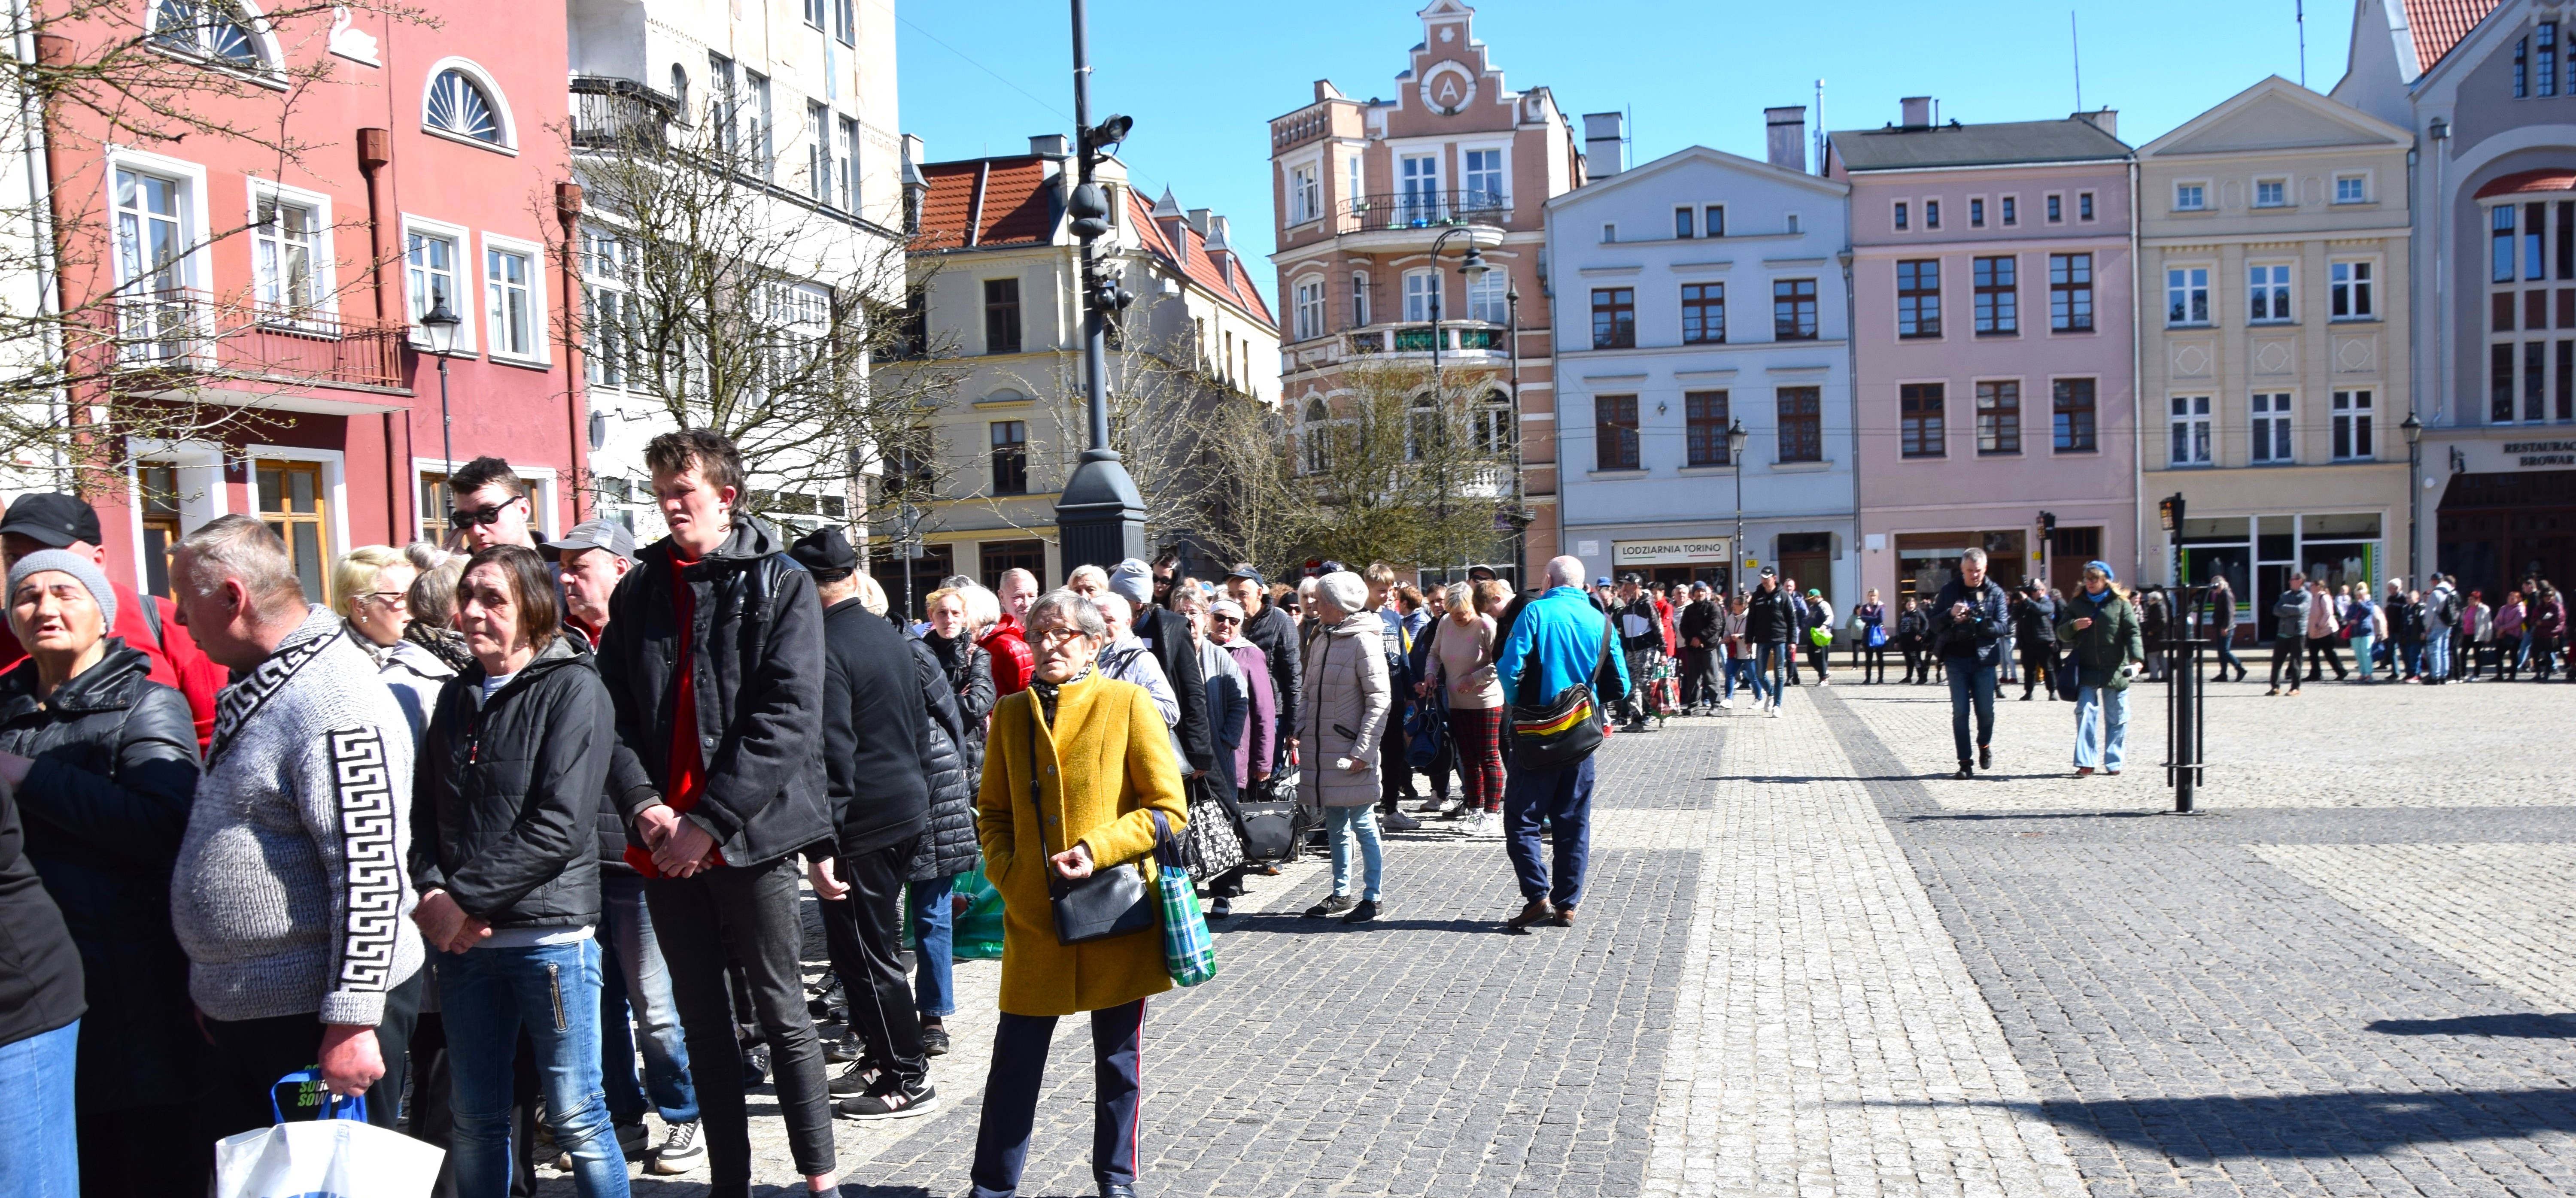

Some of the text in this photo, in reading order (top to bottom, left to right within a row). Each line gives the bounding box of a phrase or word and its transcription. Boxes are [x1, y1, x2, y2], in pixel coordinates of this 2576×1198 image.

[1439, 76, 1458, 100] A
[2520, 455, 2574, 466] BROWAR
[1623, 543, 1721, 555] LODZIARNIA TORINO
